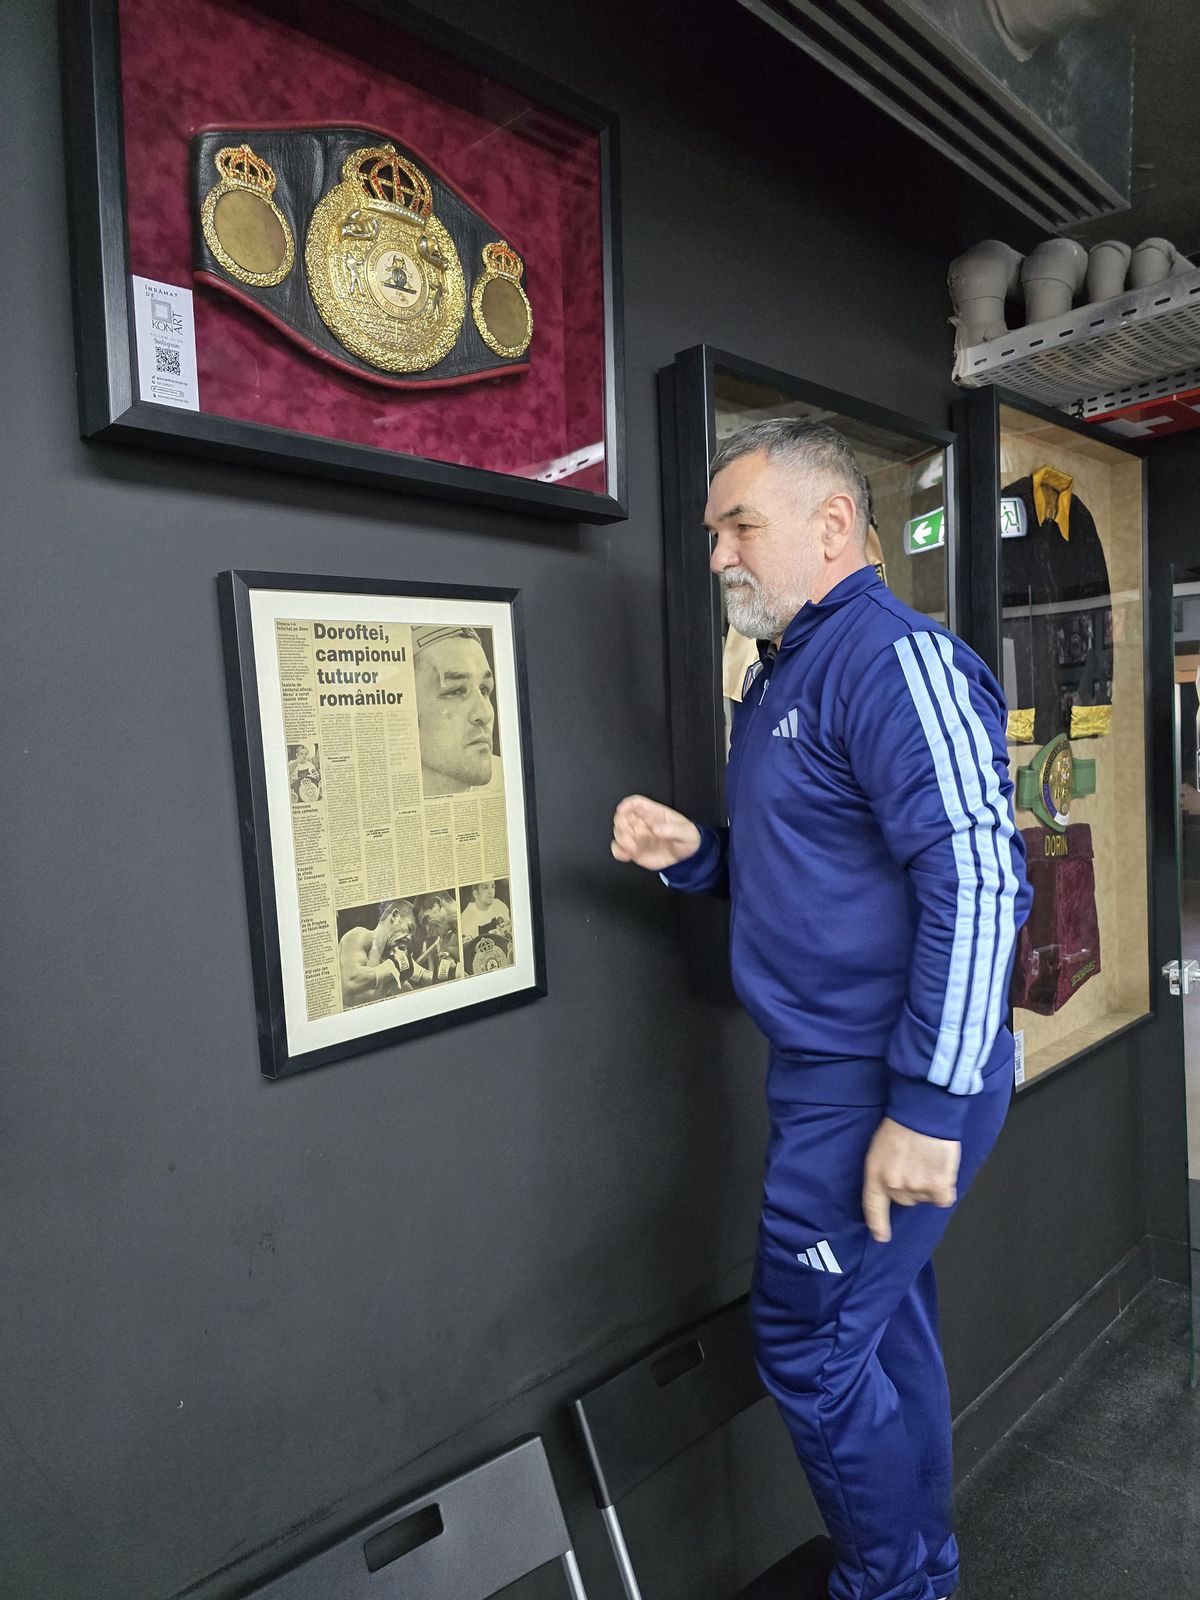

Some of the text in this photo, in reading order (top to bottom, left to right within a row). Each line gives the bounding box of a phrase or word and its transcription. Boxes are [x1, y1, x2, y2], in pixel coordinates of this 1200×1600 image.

[313, 622, 389, 644] Doroftei,
[316, 647, 406, 666] campionul
[317, 668, 378, 685] tuturor
[319, 689, 403, 707] românilor
[1044, 835, 1068, 857] DORIN
